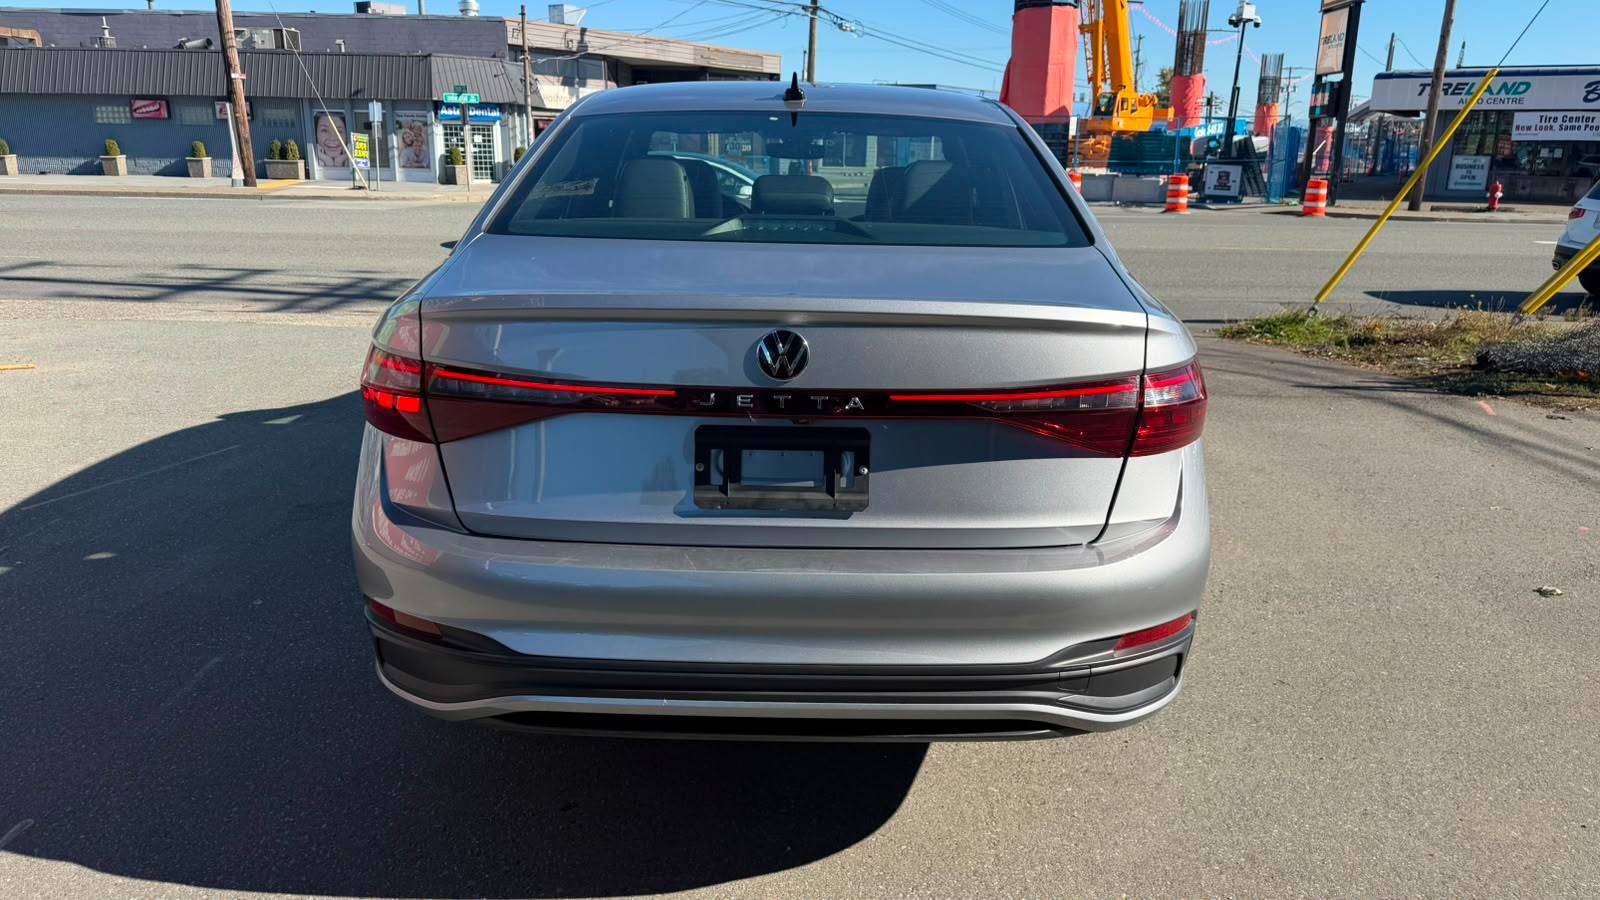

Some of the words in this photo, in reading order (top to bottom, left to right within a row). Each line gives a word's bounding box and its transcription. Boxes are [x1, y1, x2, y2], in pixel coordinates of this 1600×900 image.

[1417, 81, 1532, 97] TRELAND
[1486, 97, 1525, 105] CENTRE
[440, 105, 461, 116] Astr
[468, 106, 500, 117] Dental
[1539, 115, 1559, 124] Tire
[1561, 115, 1597, 124] Center
[1515, 124, 1533, 132] New
[1558, 124, 1582, 132] Same
[697, 392, 866, 411] JETTA
